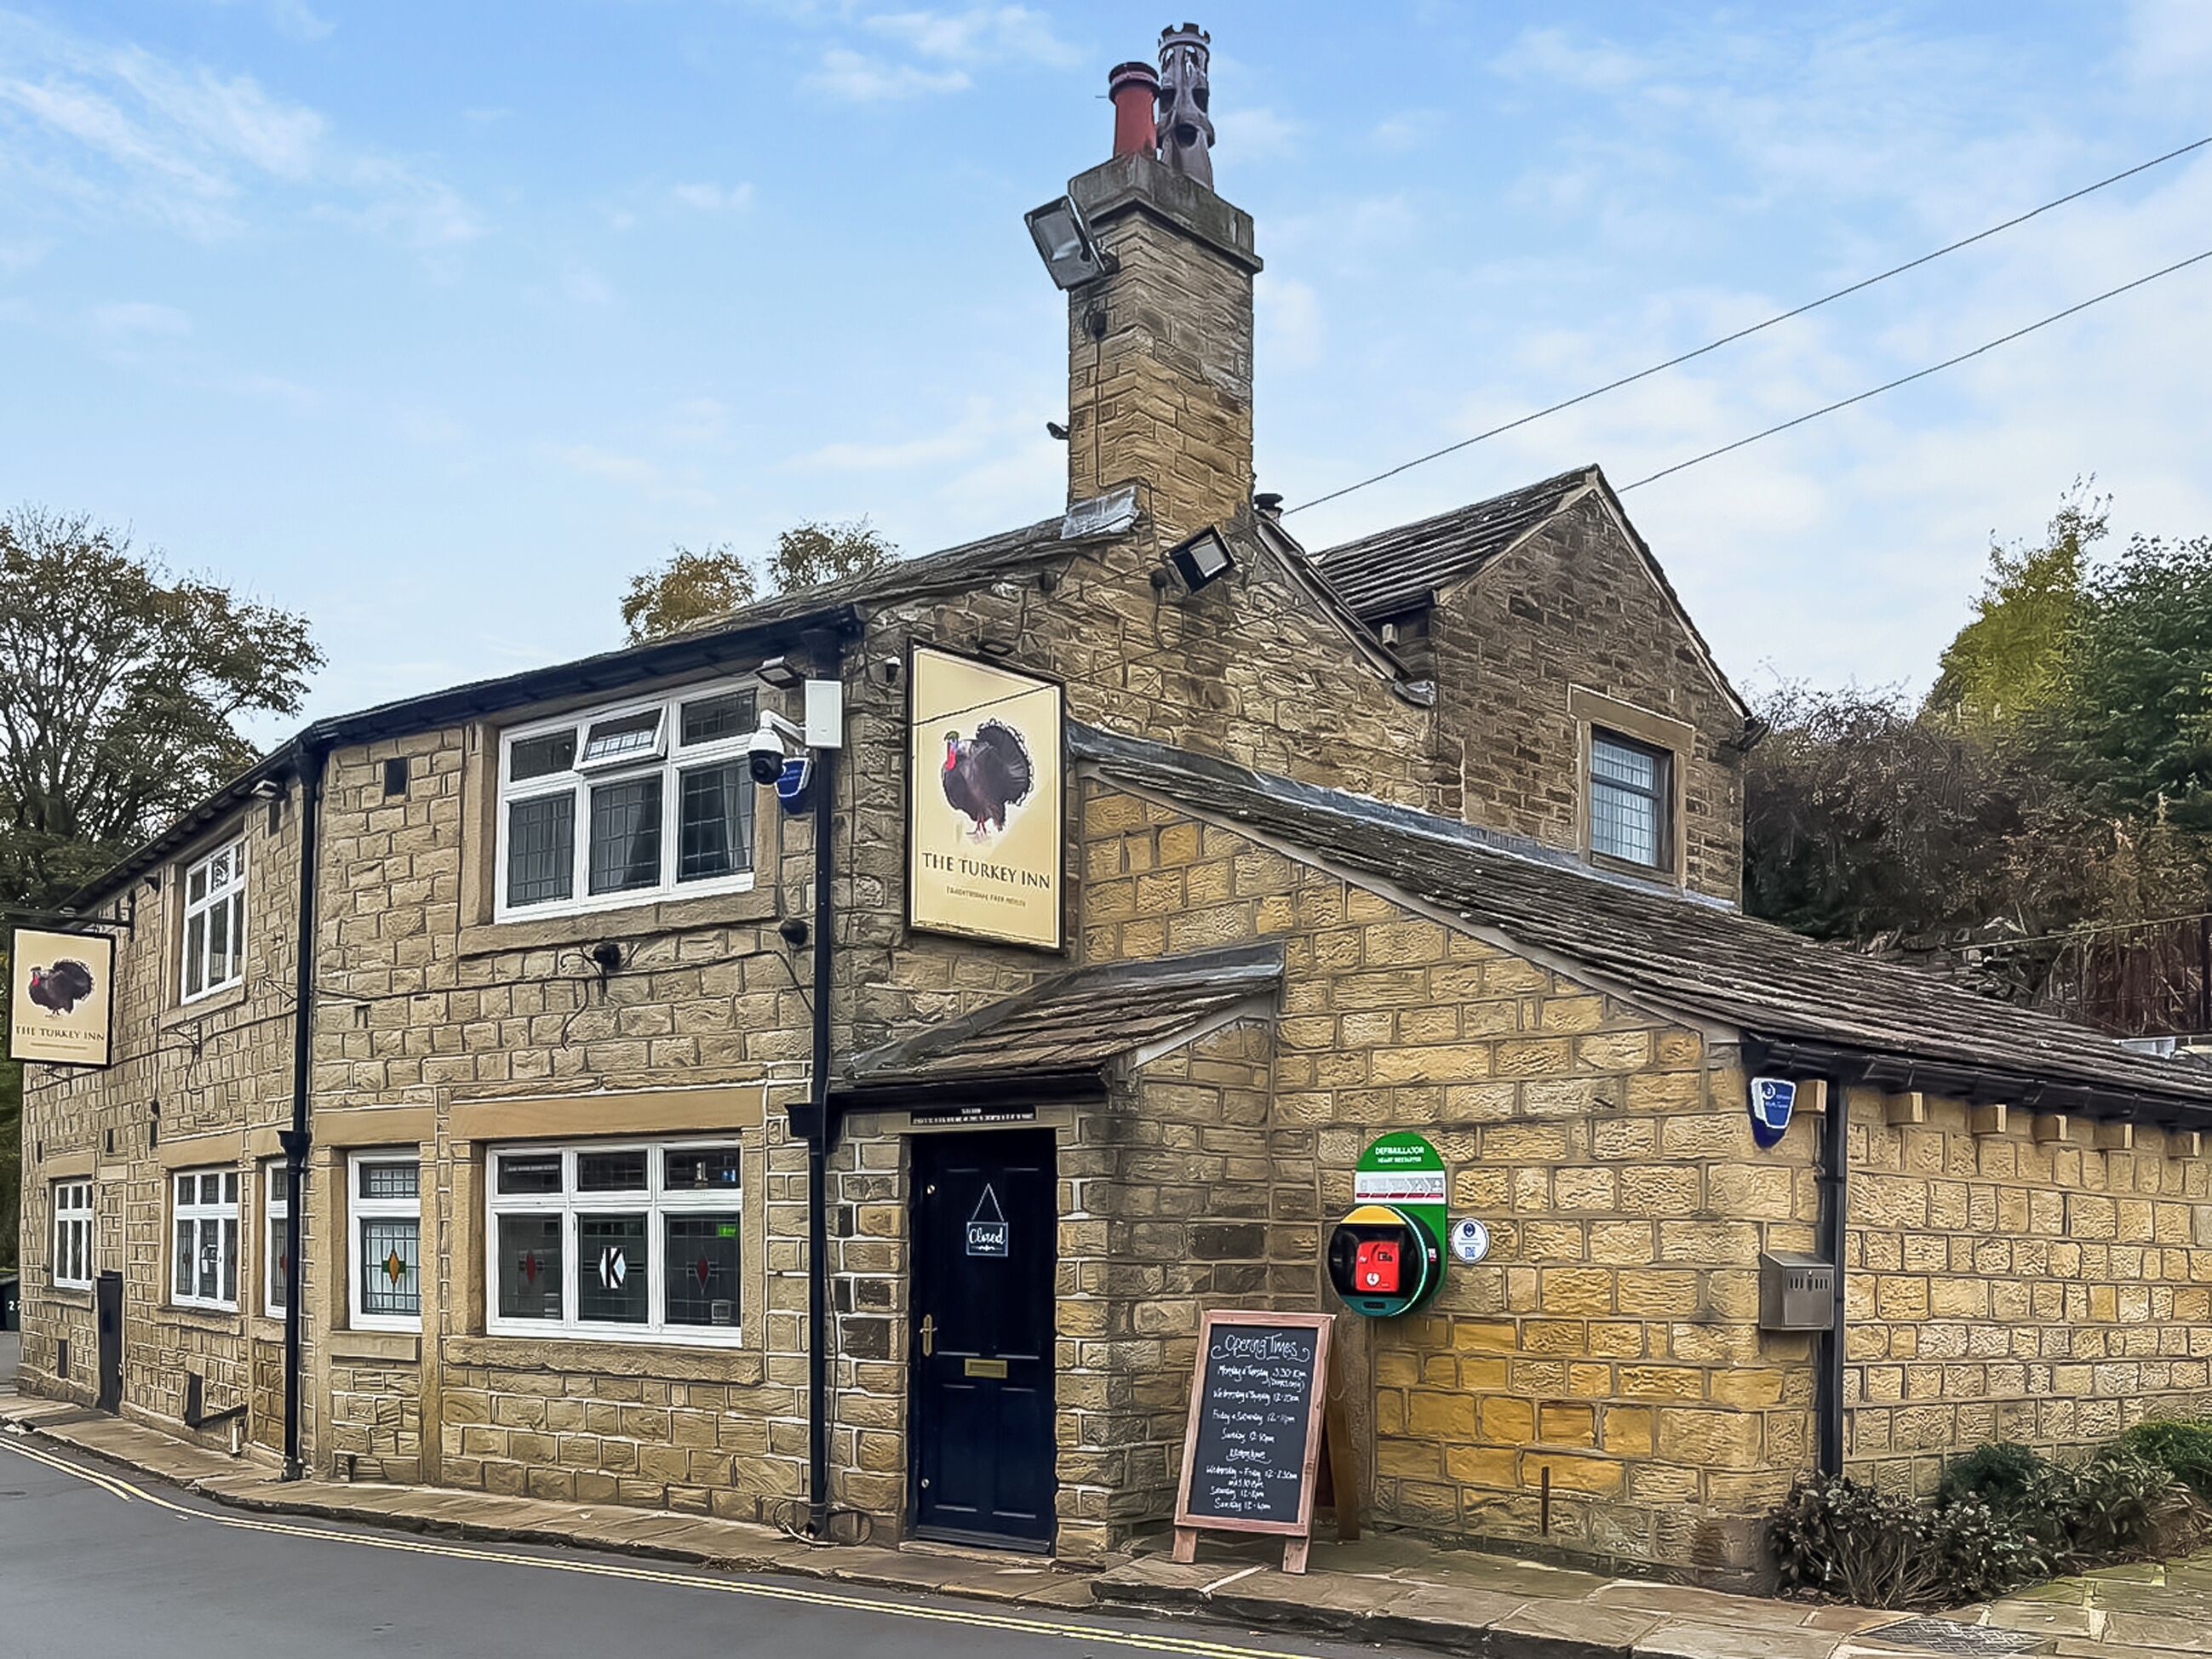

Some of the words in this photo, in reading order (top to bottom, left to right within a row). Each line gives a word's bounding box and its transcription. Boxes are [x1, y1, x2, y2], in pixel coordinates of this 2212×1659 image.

[922, 852, 954, 872] THE
[958, 858, 1017, 884] TURKEY
[1021, 870, 1051, 890] INN
[16, 1025, 35, 1036] THE
[39, 1028, 81, 1039] TURKEY
[83, 1032, 105, 1041] INN
[969, 1227, 1006, 1244] Closed
[1225, 1334, 1267, 1360] Opening
[1265, 1332, 1298, 1359] Times
[1221, 1427, 1246, 1444] Sunday
[1214, 1496, 1241, 1512] Sunday
